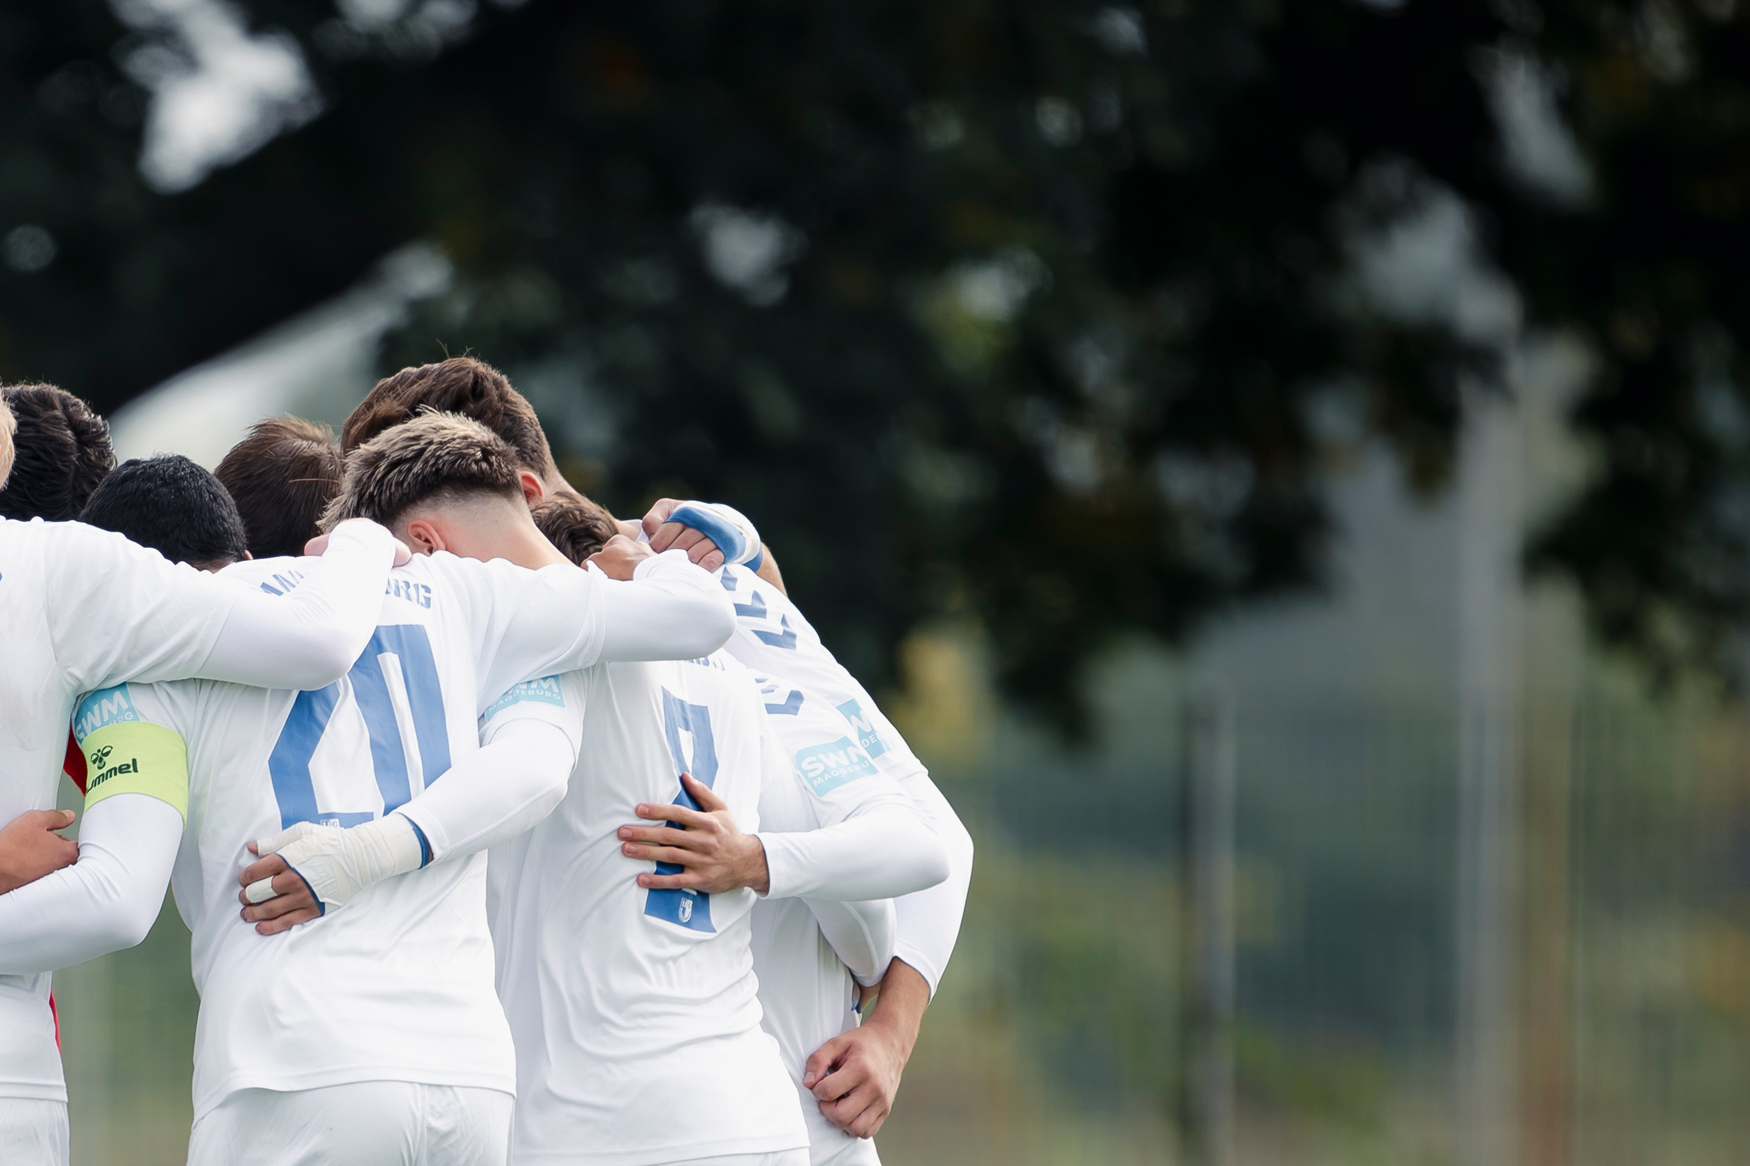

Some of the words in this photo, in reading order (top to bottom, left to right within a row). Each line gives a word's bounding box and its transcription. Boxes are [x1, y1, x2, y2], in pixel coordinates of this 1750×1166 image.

[76, 690, 129, 741] SWM
[268, 624, 452, 832] 20
[86, 758, 139, 793] ummel
[812, 760, 870, 787] MAGDEBU
